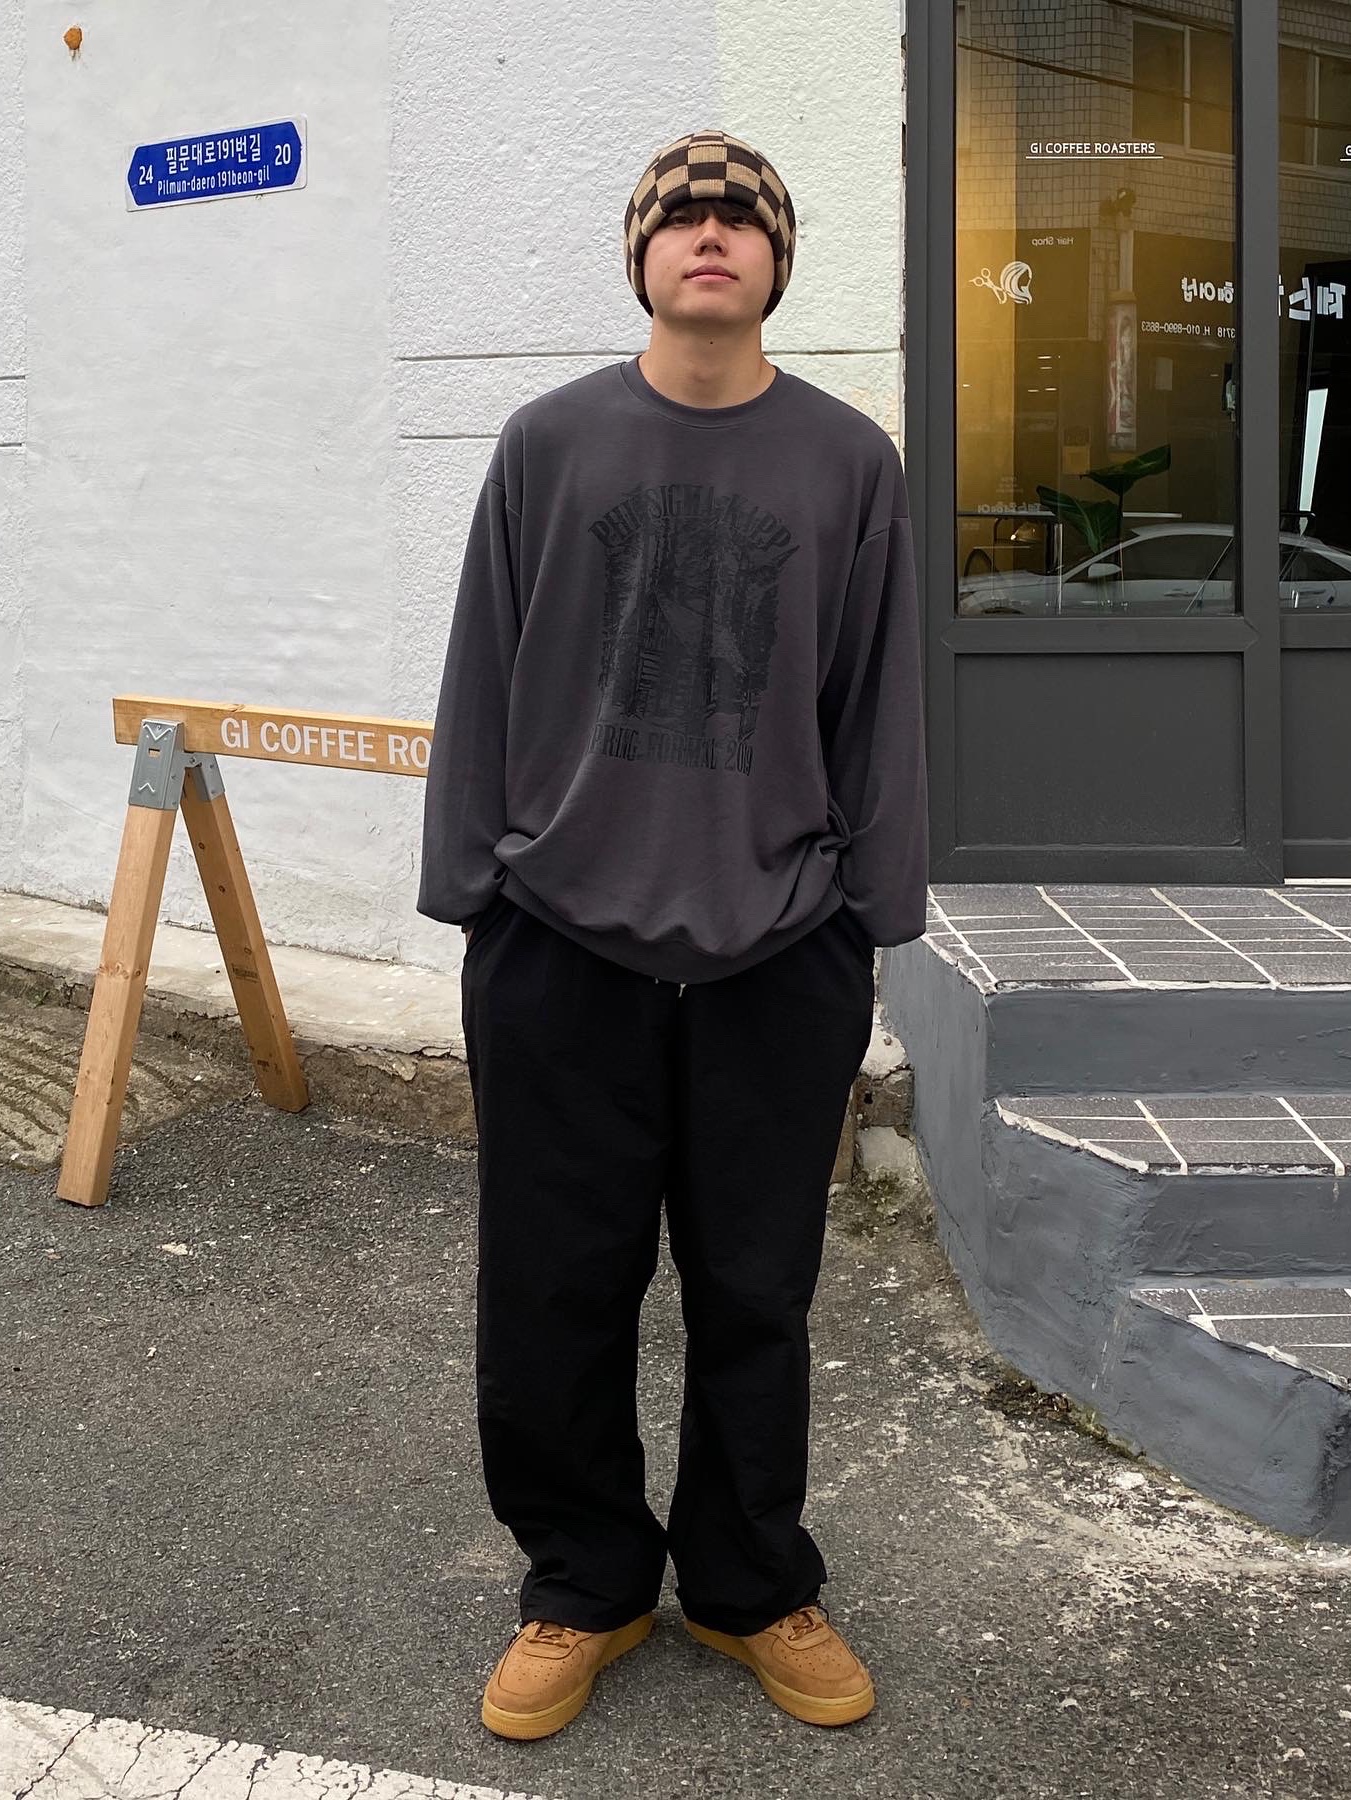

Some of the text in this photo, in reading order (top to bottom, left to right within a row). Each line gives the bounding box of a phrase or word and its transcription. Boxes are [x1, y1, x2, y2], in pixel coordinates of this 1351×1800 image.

[166, 133, 261, 175] 필문대로191번길
[275, 143, 291, 166] 20
[1030, 142, 1156, 154] GI COFFEE ROASTERS
[138, 165, 154, 186] 24
[157, 164, 270, 196] Pilmun-daero 191beon-gil
[220, 717, 249, 749] GI
[260, 721, 376, 763] COFFEE
